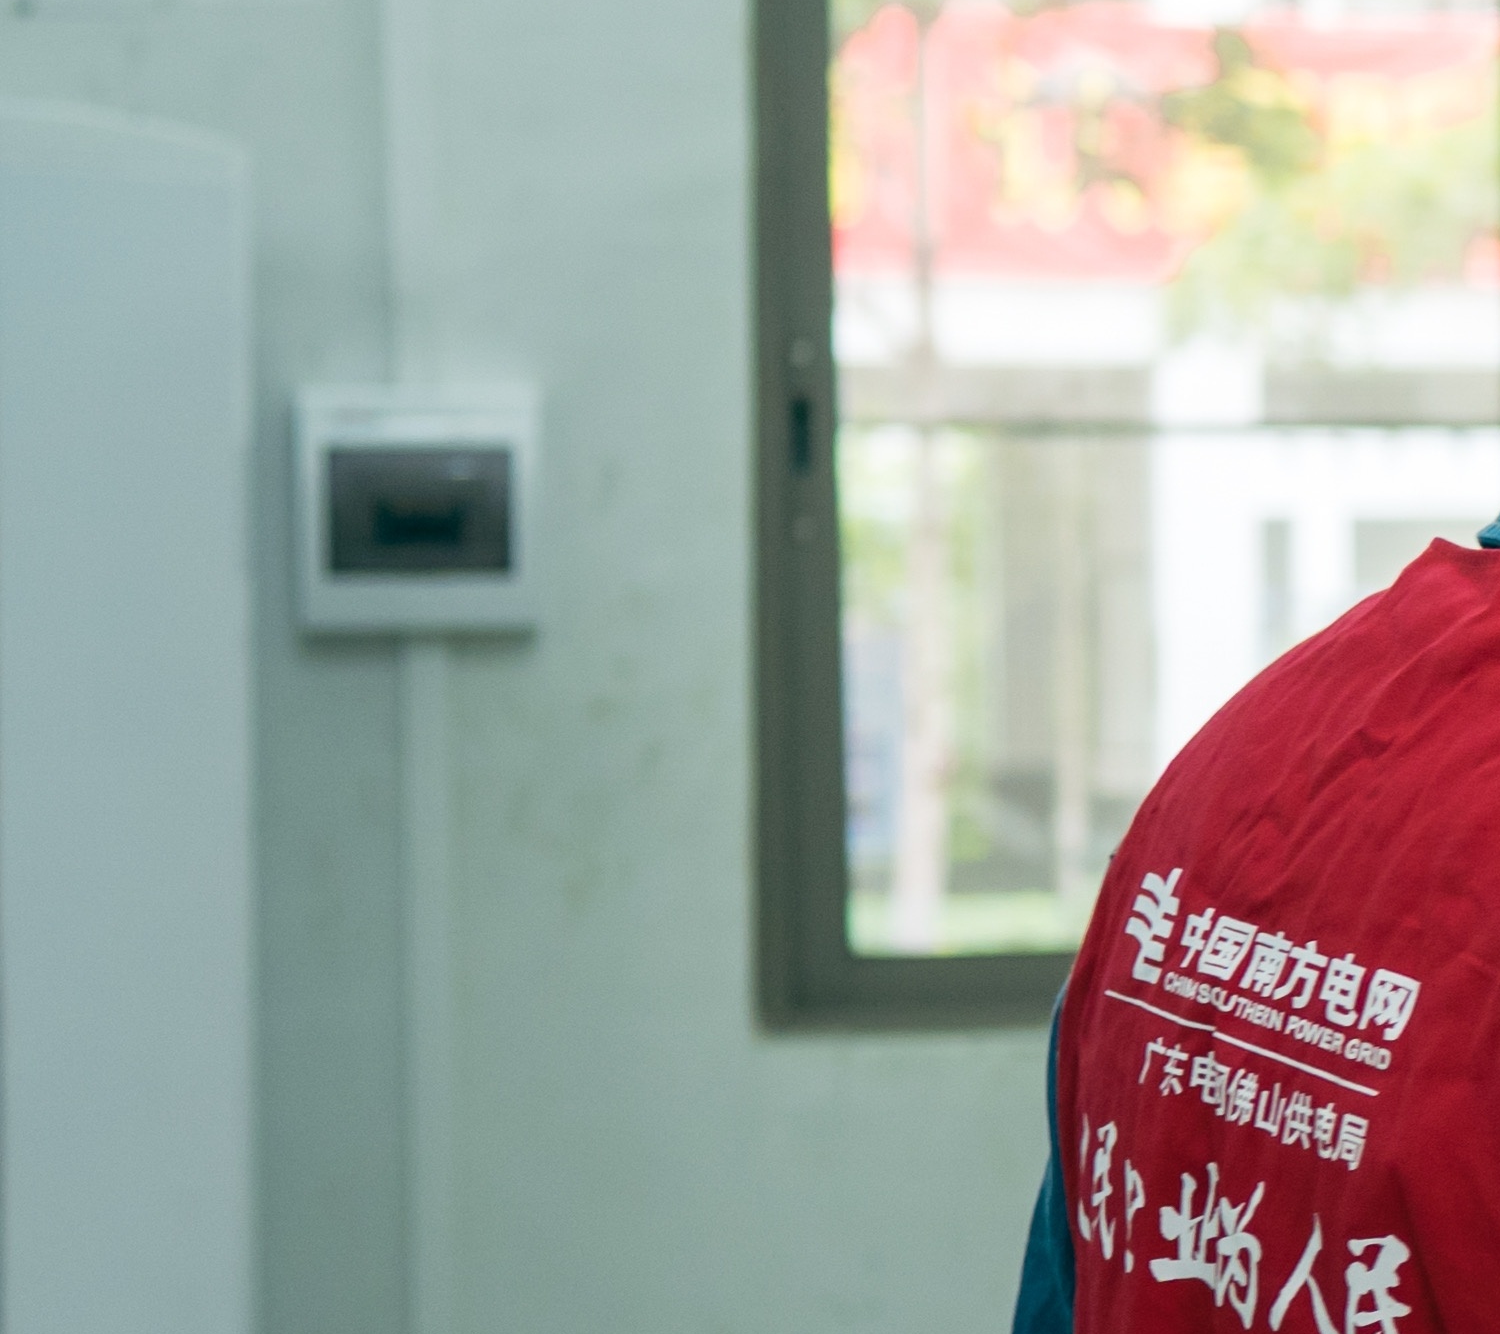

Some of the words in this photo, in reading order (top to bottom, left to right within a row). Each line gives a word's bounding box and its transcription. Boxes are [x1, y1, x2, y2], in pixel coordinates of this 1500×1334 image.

[1180, 906, 1422, 1043] 中国南方电网
[1284, 1013, 1346, 1057] POWER
[1343, 1037, 1393, 1072] GRID
